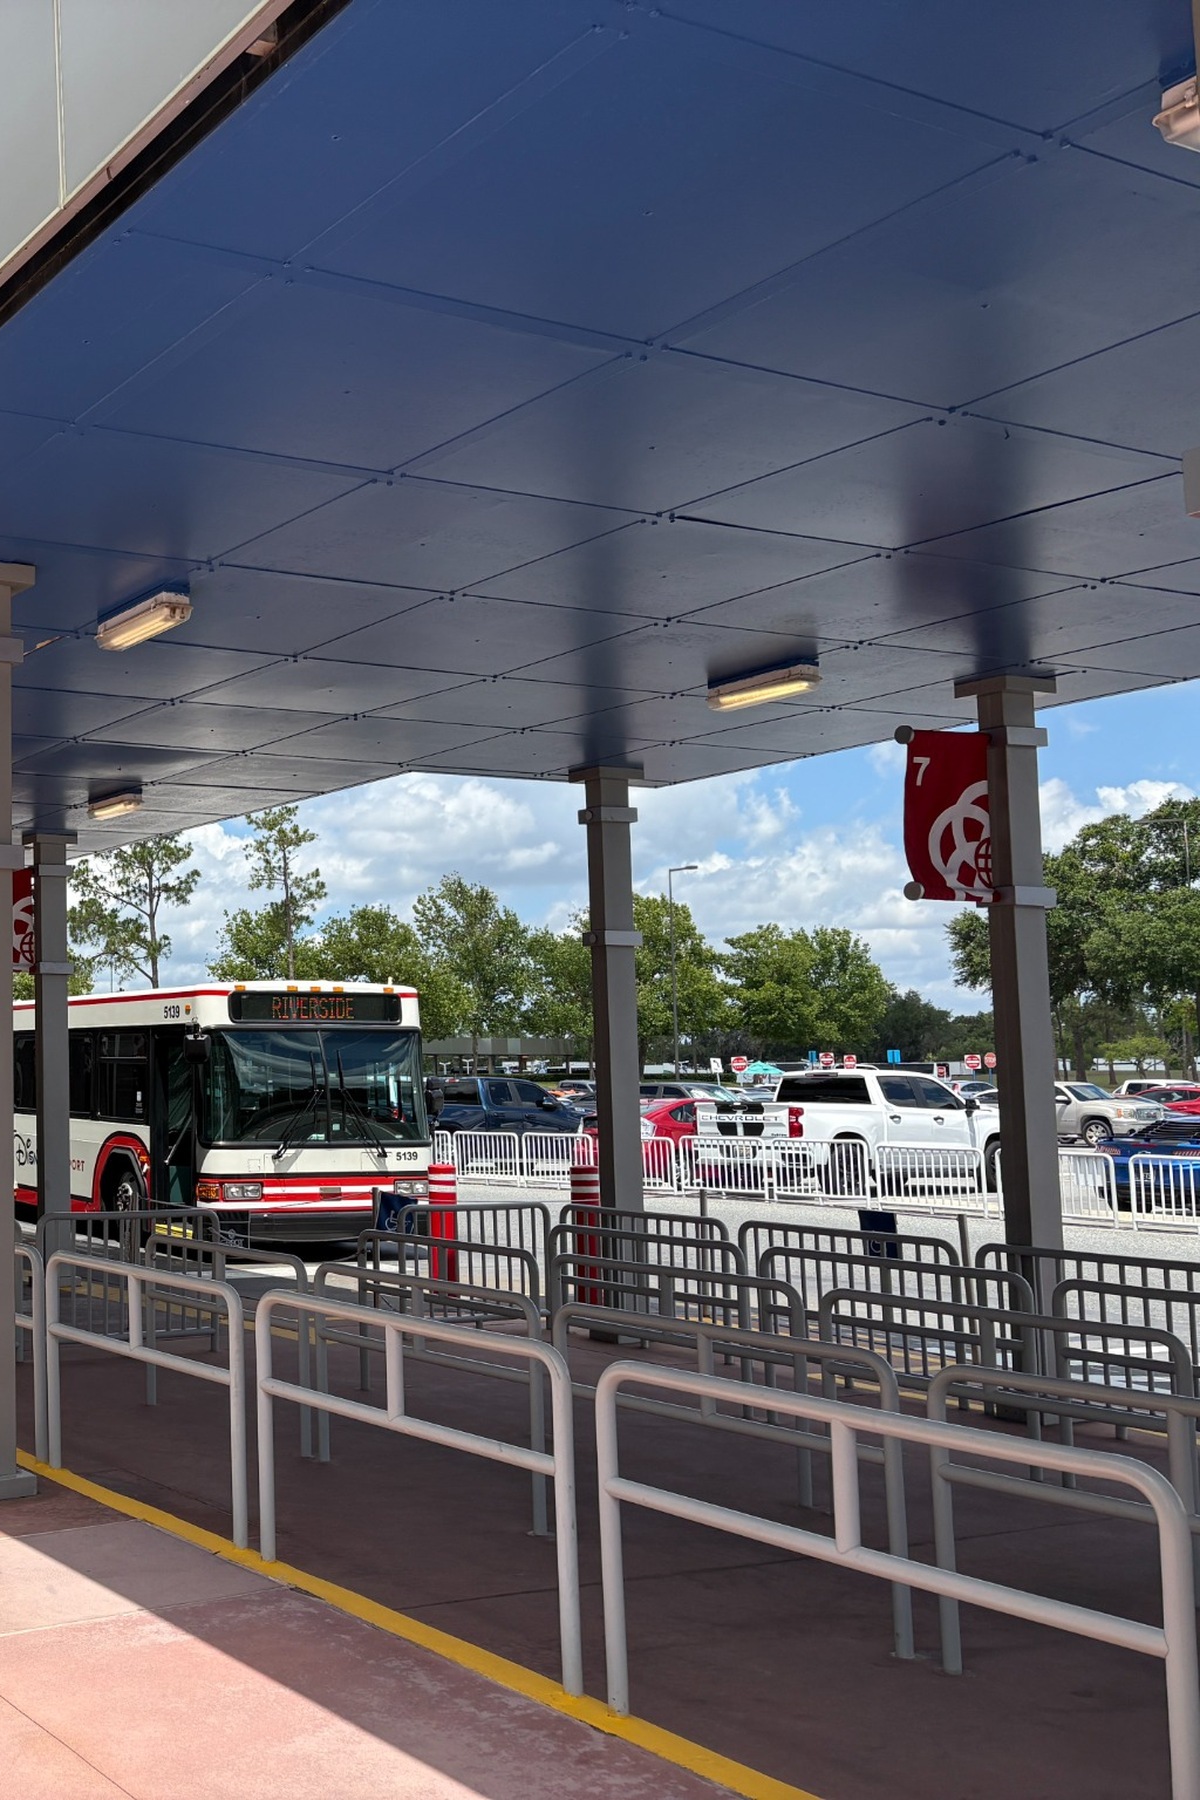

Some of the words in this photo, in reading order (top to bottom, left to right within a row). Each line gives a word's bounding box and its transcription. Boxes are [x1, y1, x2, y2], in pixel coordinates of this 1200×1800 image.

[912, 756, 931, 786] 7
[163, 1005, 180, 1019] 5139
[272, 996, 355, 1019] RIVERSIDE
[396, 1151, 418, 1161] 5139
